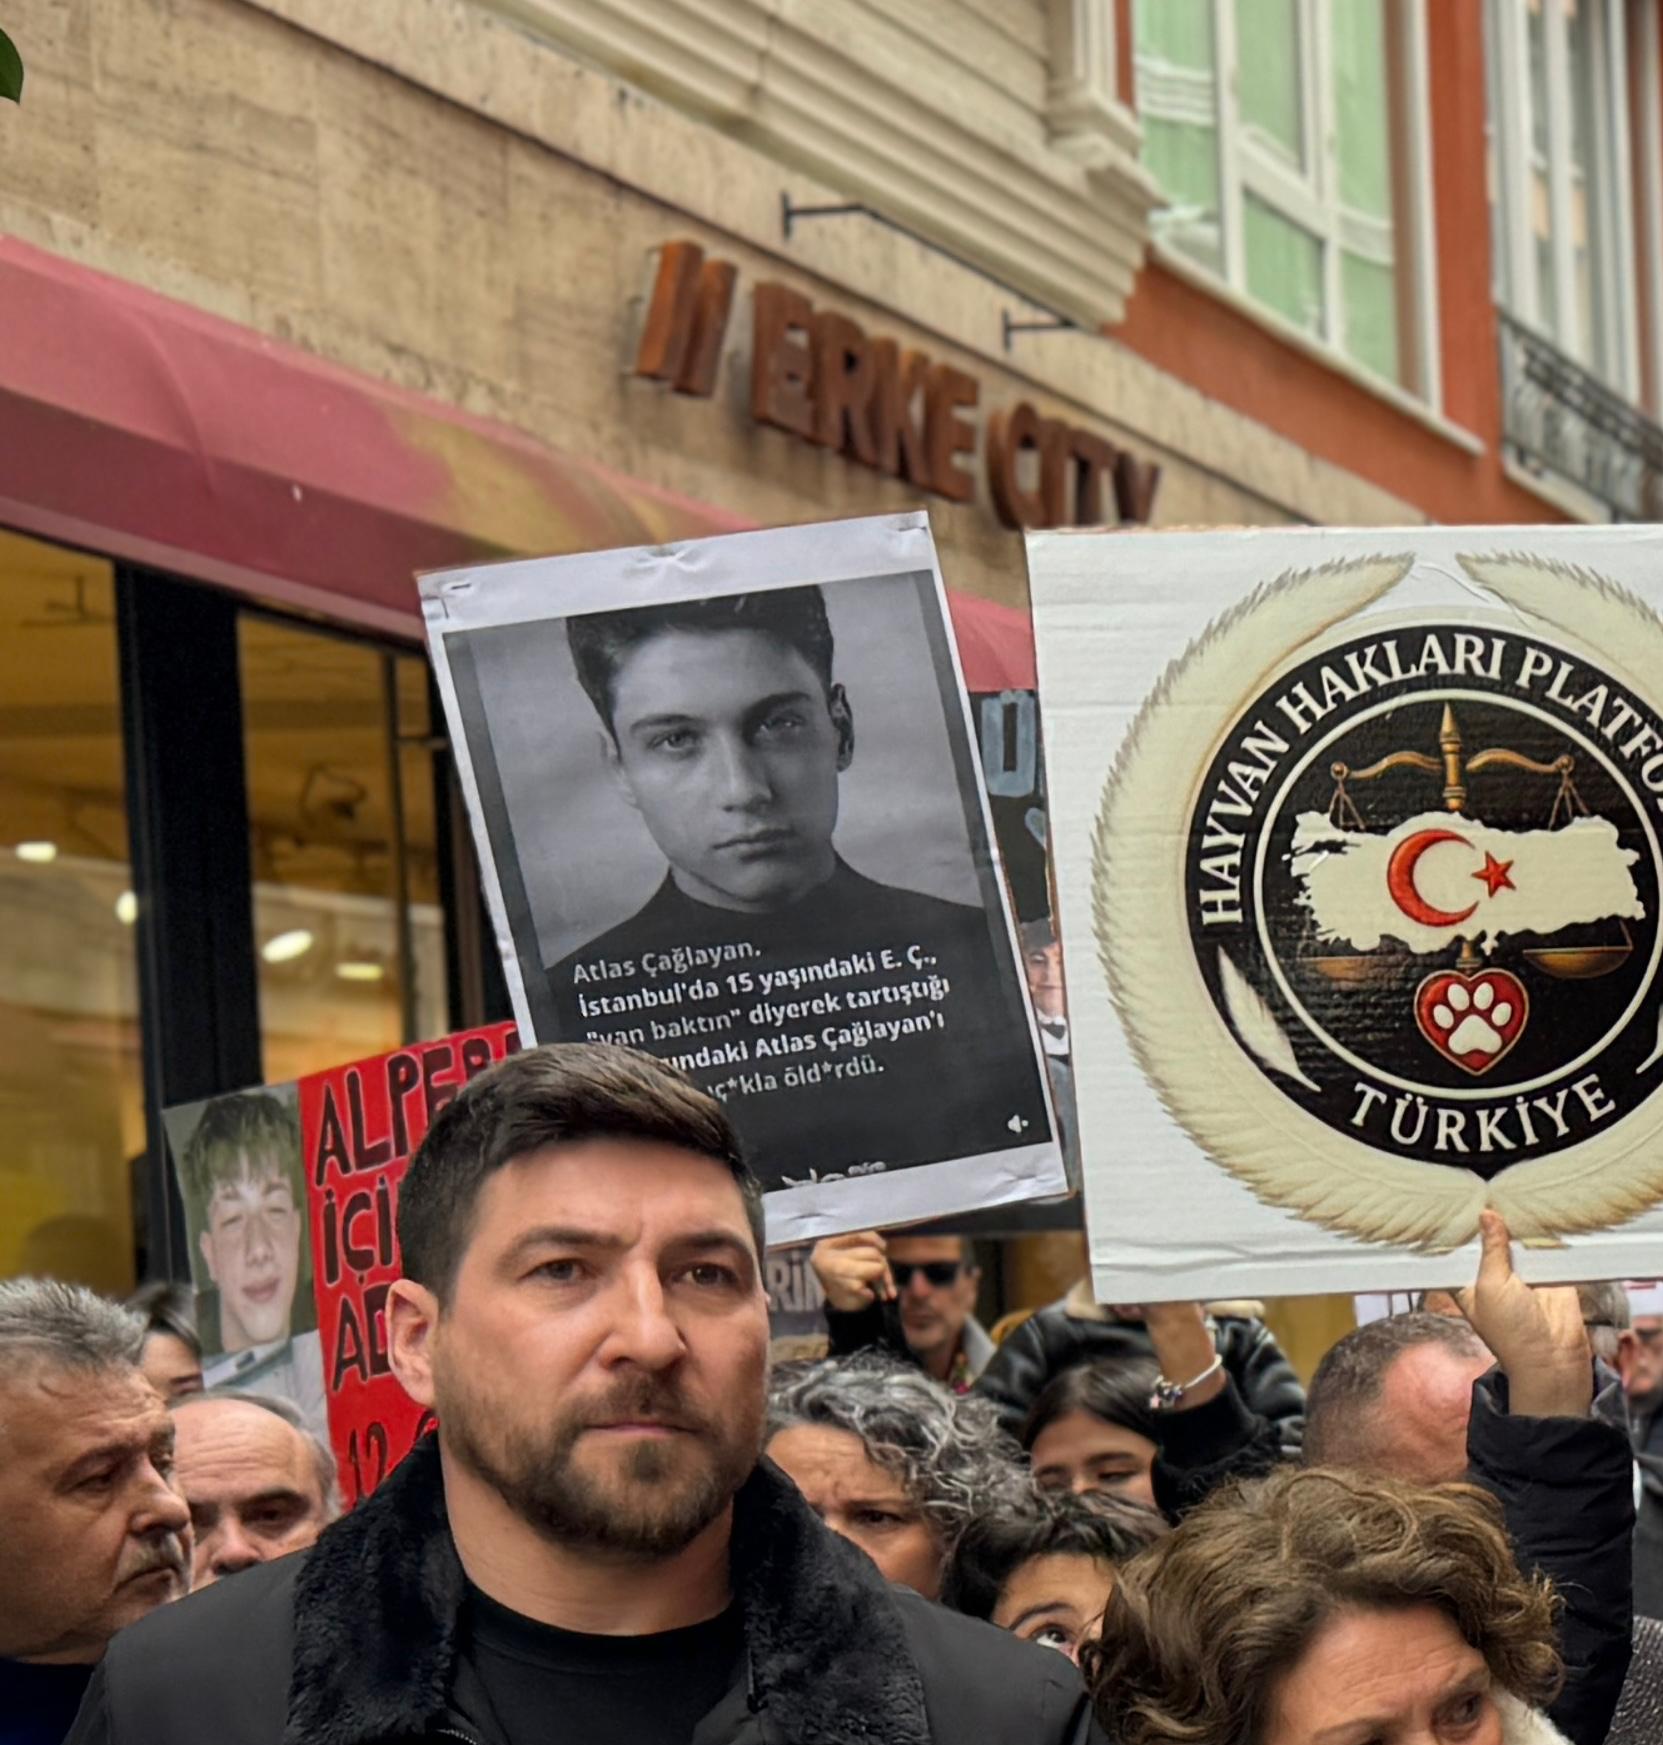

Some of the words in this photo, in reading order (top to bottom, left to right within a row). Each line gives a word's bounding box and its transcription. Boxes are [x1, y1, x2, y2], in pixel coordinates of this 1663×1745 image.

[986, 402, 1160, 528] CITY
[1199, 720, 1290, 926] HAYVAN
[1275, 632, 1506, 734] HAKLARI
[573, 959, 636, 984] Atlas
[577, 979, 720, 1018] İstanbul'da
[726, 972, 754, 994] 15
[758, 951, 876, 996] yaşındaki
[880, 949, 902, 970] E.
[650, 1008, 741, 1040] baktın"
[749, 992, 841, 1027] diyerek
[846, 974, 951, 1005] tartıştığı
[664, 1041, 749, 1071] ındaki
[755, 1034, 817, 1058] Atlas
[821, 1010, 945, 1052] Çağlayan'ı
[1351, 1073, 1616, 1152] TÜRKİYE
